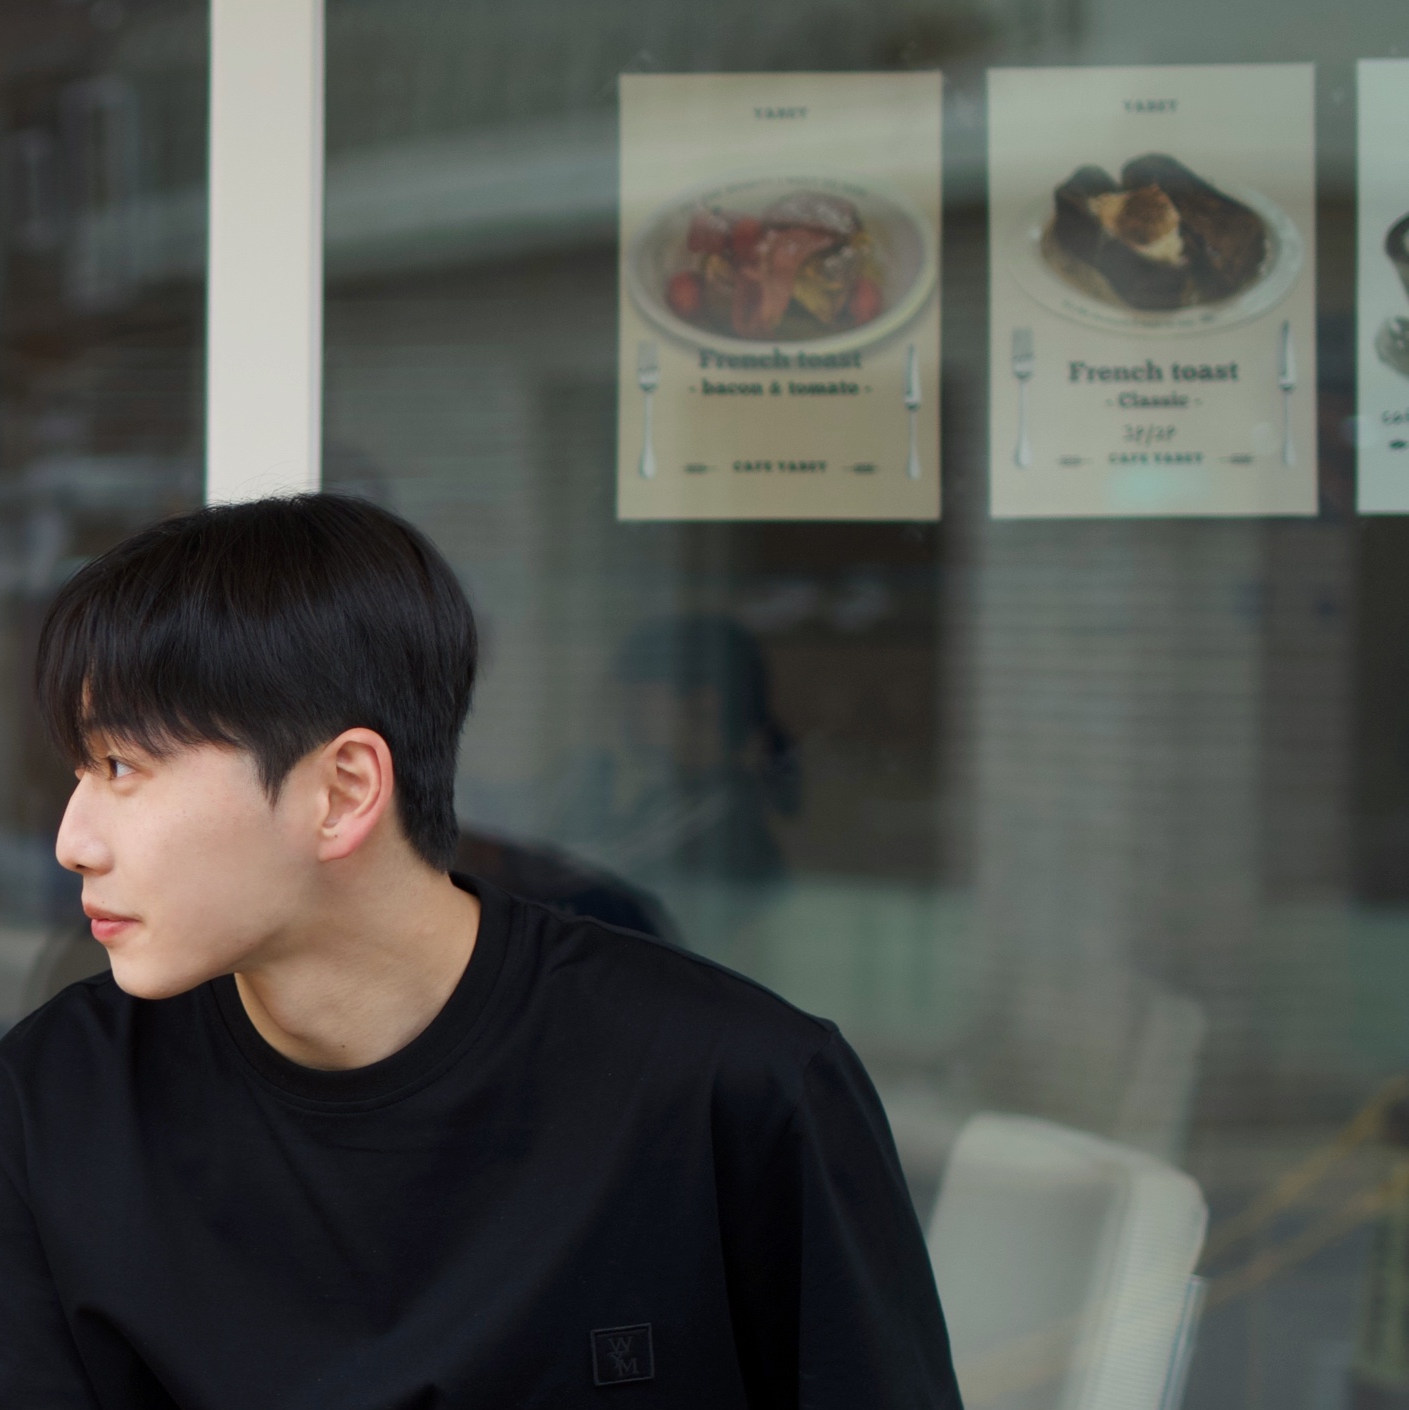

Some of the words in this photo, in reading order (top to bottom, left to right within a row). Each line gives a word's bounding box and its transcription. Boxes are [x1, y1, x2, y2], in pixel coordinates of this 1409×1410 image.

[698, 346, 790, 370] French
[797, 350, 862, 370] toast
[1068, 358, 1164, 383] French
[1171, 360, 1240, 383] toast
[787, 379, 860, 396] tomato
[1117, 390, 1190, 409] Classic
